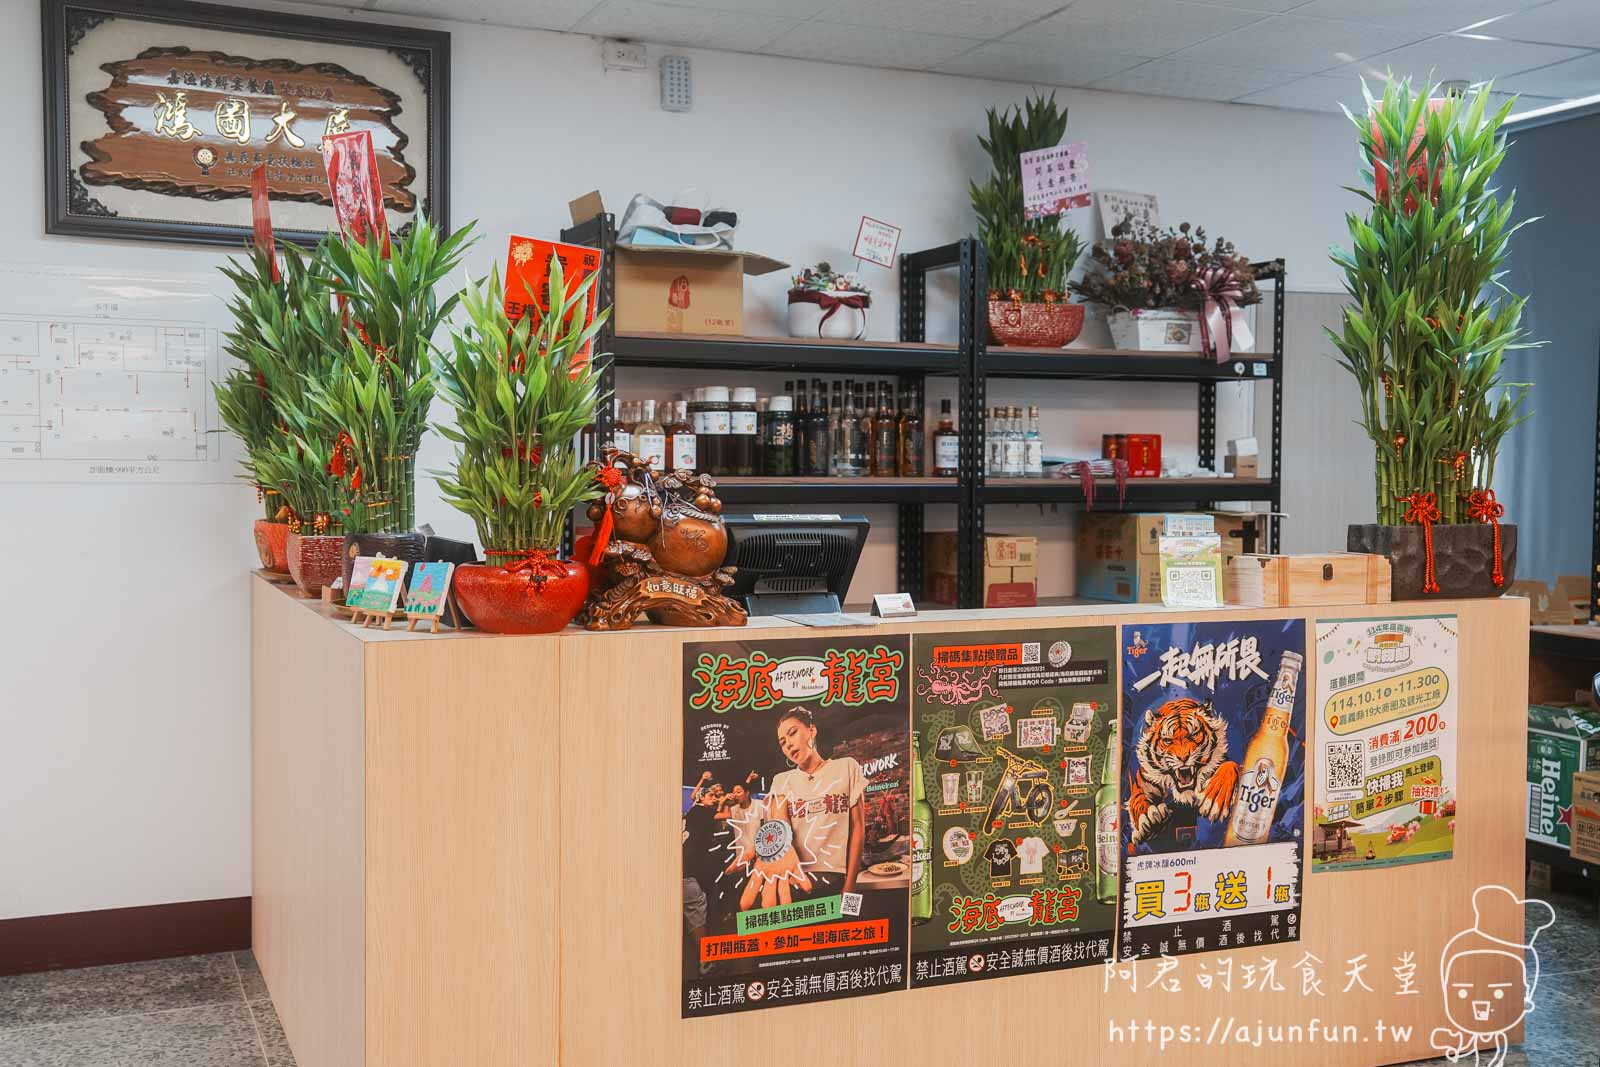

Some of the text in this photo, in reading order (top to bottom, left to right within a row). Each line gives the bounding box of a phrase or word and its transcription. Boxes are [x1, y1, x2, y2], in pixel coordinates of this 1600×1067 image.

[646, 580, 698, 599] 如意旺福
[937, 648, 1018, 663] 掃碼集點換贈品
[1127, 646, 1149, 658] Tiger
[691, 652, 784, 711] 海底
[775, 667, 815, 683] AFTERWORK
[819, 646, 903, 706] 龍宮
[1271, 688, 1296, 704] Tiger
[1240, 784, 1276, 813] Tiger
[756, 823, 783, 844] Heineken
[745, 901, 836, 930] 掃碼集點換贈品！
[948, 894, 1005, 933] 海底
[1028, 886, 1082, 927] 龍宮
[916, 956, 968, 981] 禁止酒駕
[986, 938, 1110, 972] 安全誠無價酒後找代駕
[688, 963, 903, 1010] 禁止酒駕 安全誠無價酒後找代駕
